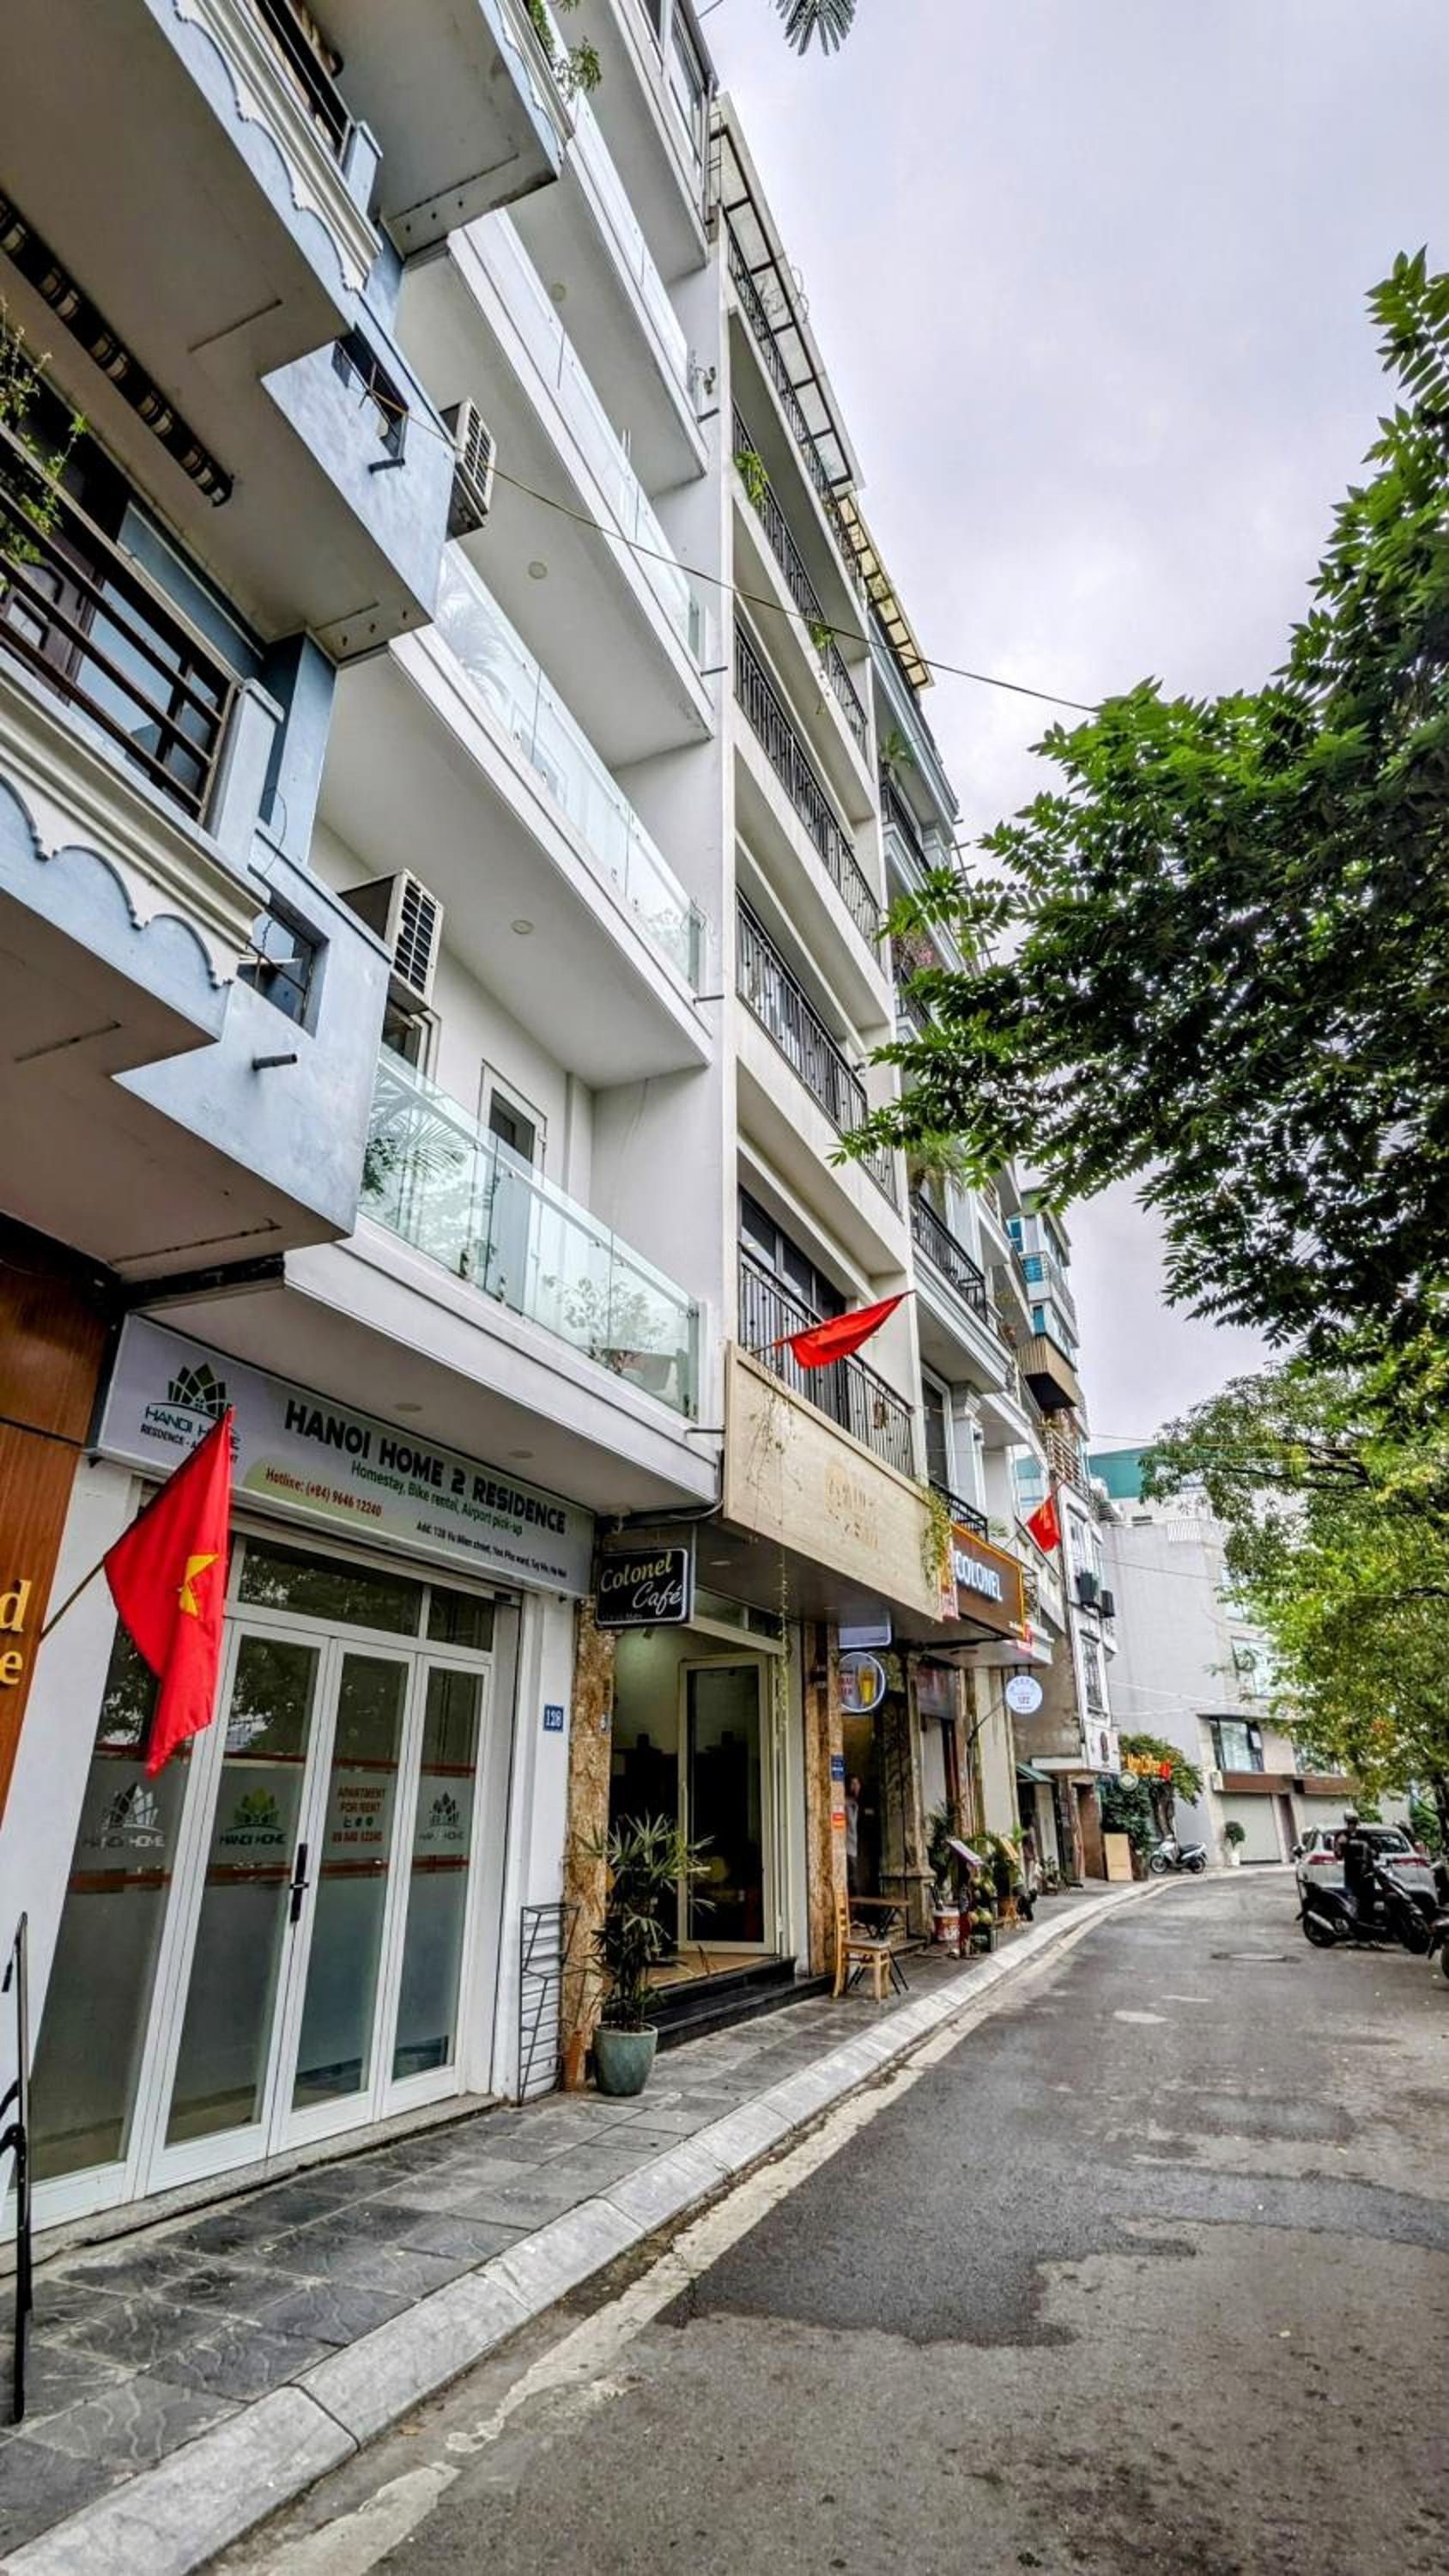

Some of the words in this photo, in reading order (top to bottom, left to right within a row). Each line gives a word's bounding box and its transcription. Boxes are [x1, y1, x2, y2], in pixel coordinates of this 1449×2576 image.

[144, 1405, 194, 1433] HANOI
[284, 1399, 372, 1460] HANOI
[379, 1437, 445, 1487] HOME
[451, 1467, 466, 1496] 2
[473, 1476, 567, 1534] RESIDENCE
[264, 1467, 305, 1492] Hotline:
[356, 1498, 382, 1517] 12240
[351, 1461, 407, 1496] Homestay,
[408, 1482, 430, 1503] Bike
[461, 1502, 492, 1525] Airport
[601, 1552, 673, 1593] Colonel
[632, 1580, 683, 1615] Café
[953, 1549, 1003, 1603] COLONEL
